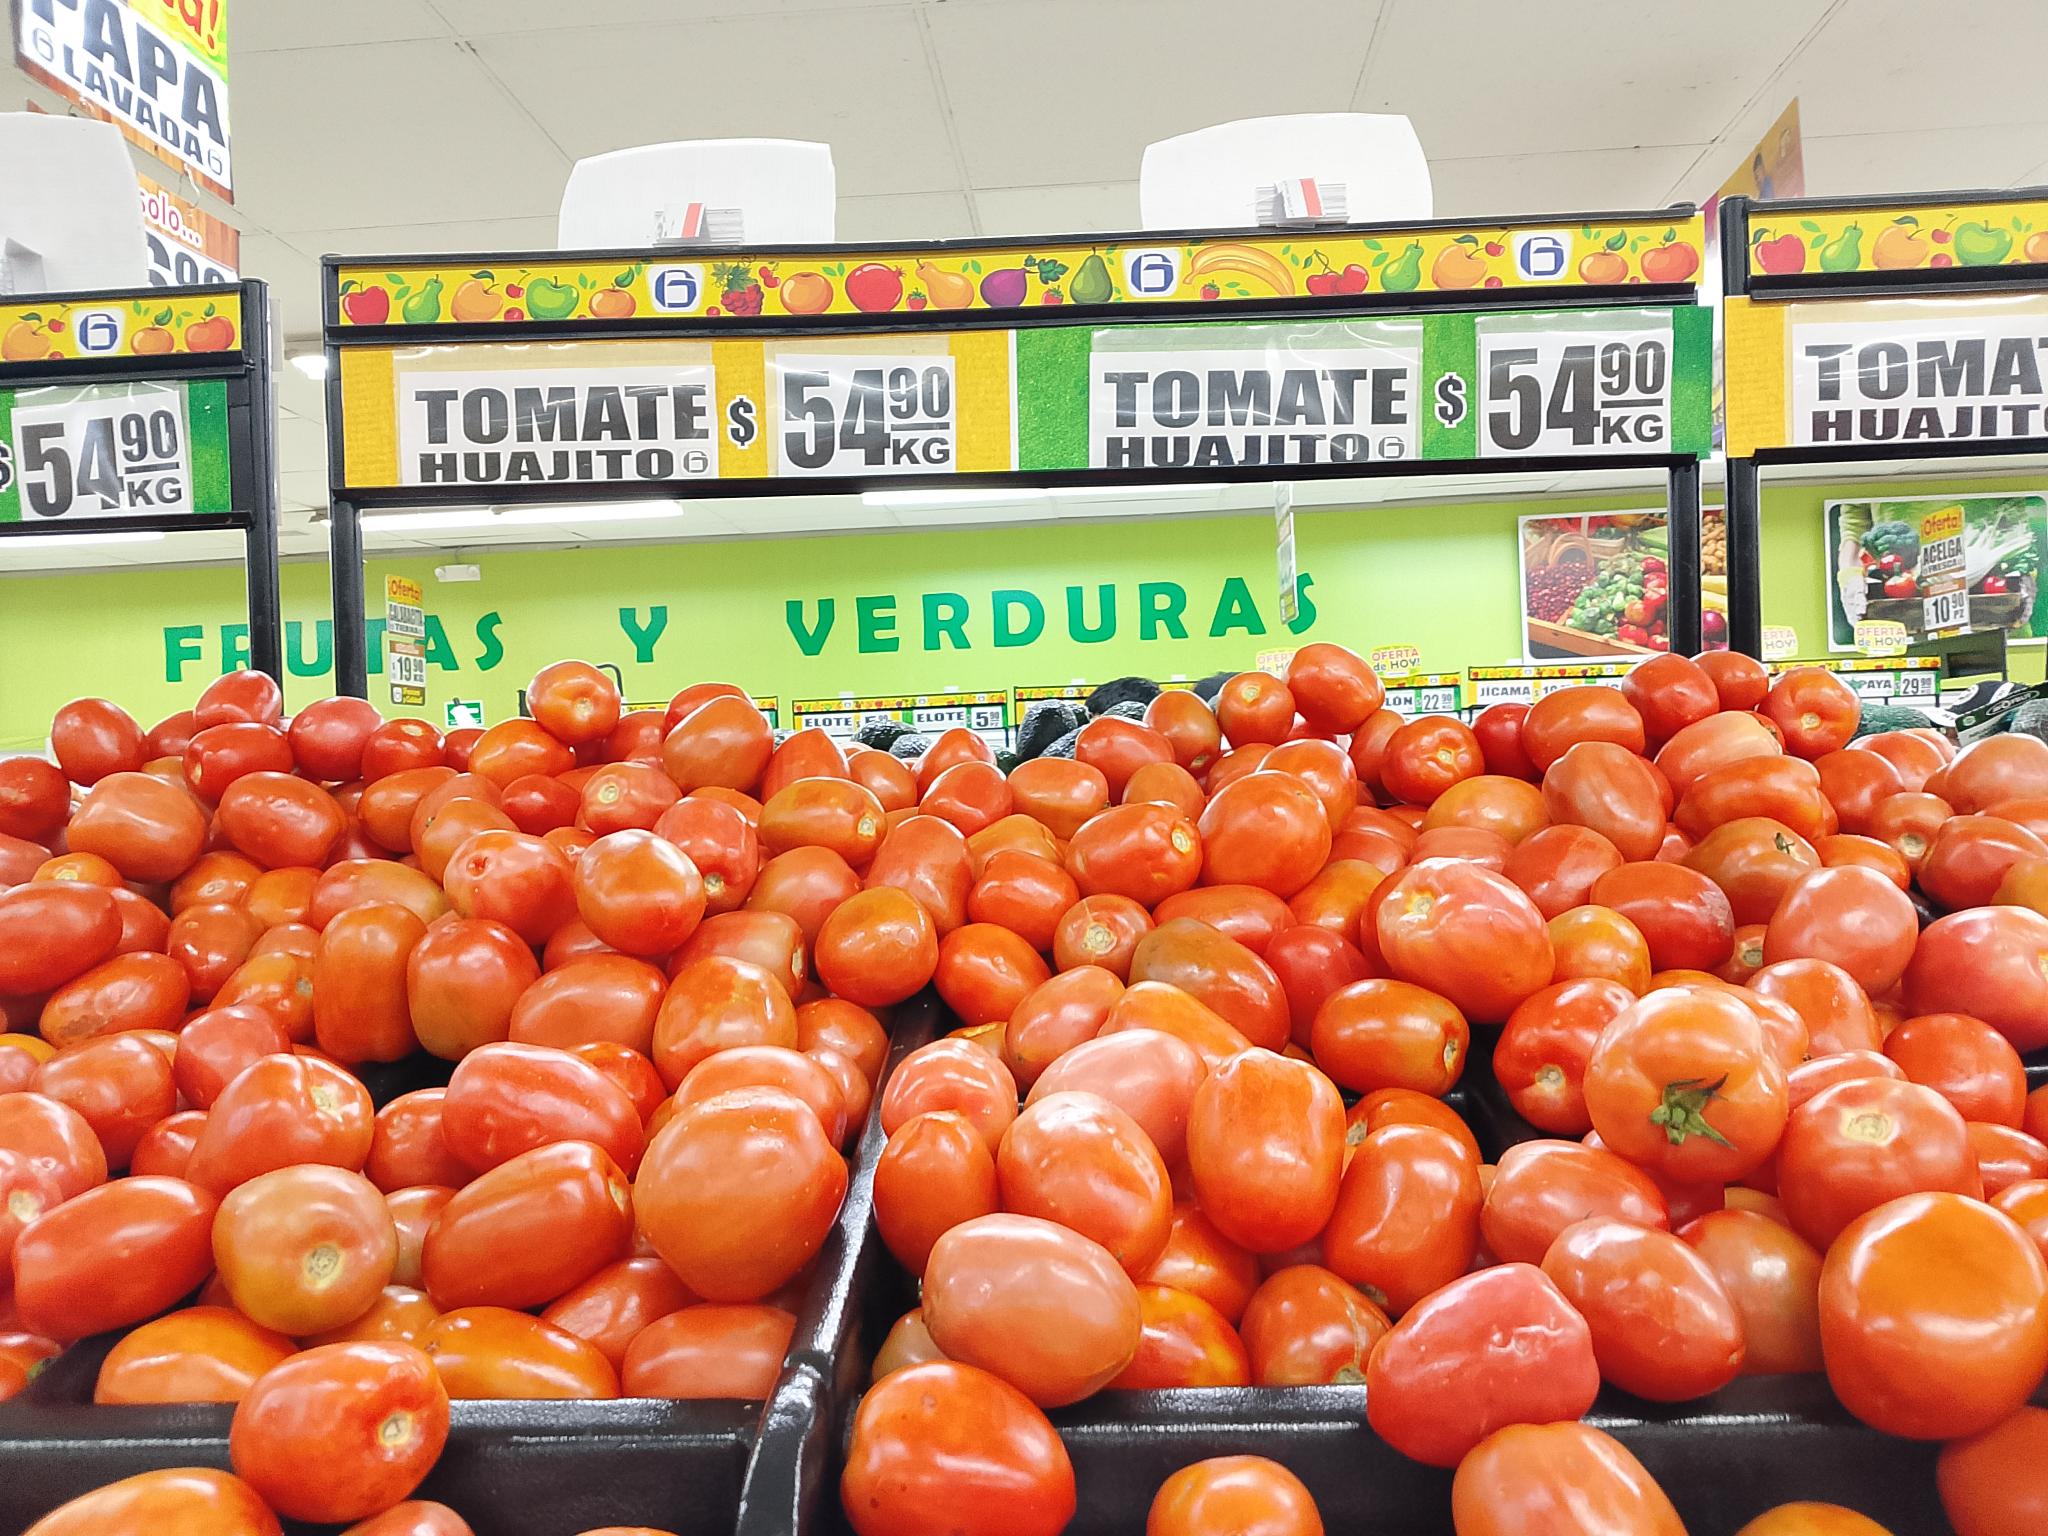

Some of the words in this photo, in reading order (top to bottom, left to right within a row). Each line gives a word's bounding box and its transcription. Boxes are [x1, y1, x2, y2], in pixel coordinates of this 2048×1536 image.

[63, 43, 204, 164] LAVADA
[1805, 337, 2048, 401] TOMA
[1104, 368, 1408, 428] TOMATE
[1438, 376, 1463, 424] $
[415, 385, 709, 444] TOMATE
[730, 398, 755, 446] $
[1602, 414, 1664, 444] KG
[1812, 404, 2048, 442] HUAJIT
[892, 437, 950, 465] KG
[1106, 433, 1370, 467] HUAJITO
[419, 448, 674, 482] HUAJITO
[127, 477, 182, 507] KG
[1923, 537, 1962, 566] ACELGA
[619, 606, 668, 664] Y
[786, 573, 1317, 656] VERDURAS
[1932, 597, 1950, 624] 10
[1857, 626, 1904, 636] OFERTA
[1858, 637, 1871, 647] de
[1875, 637, 1906, 646] HOY!
[397, 656, 412, 682] 19
[1371, 648, 1419, 661] OFERTA
[1373, 662, 1386, 671] de
[1390, 658, 1420, 670] HOY!
[1479, 685, 1531, 697] JÍCAMA
[1902, 678, 1919, 694] 29
[1423, 694, 1439, 710] 22
[804, 717, 852, 727] ELOTE
[917, 711, 964, 723] ELOTE
[976, 711, 989, 727] 5
